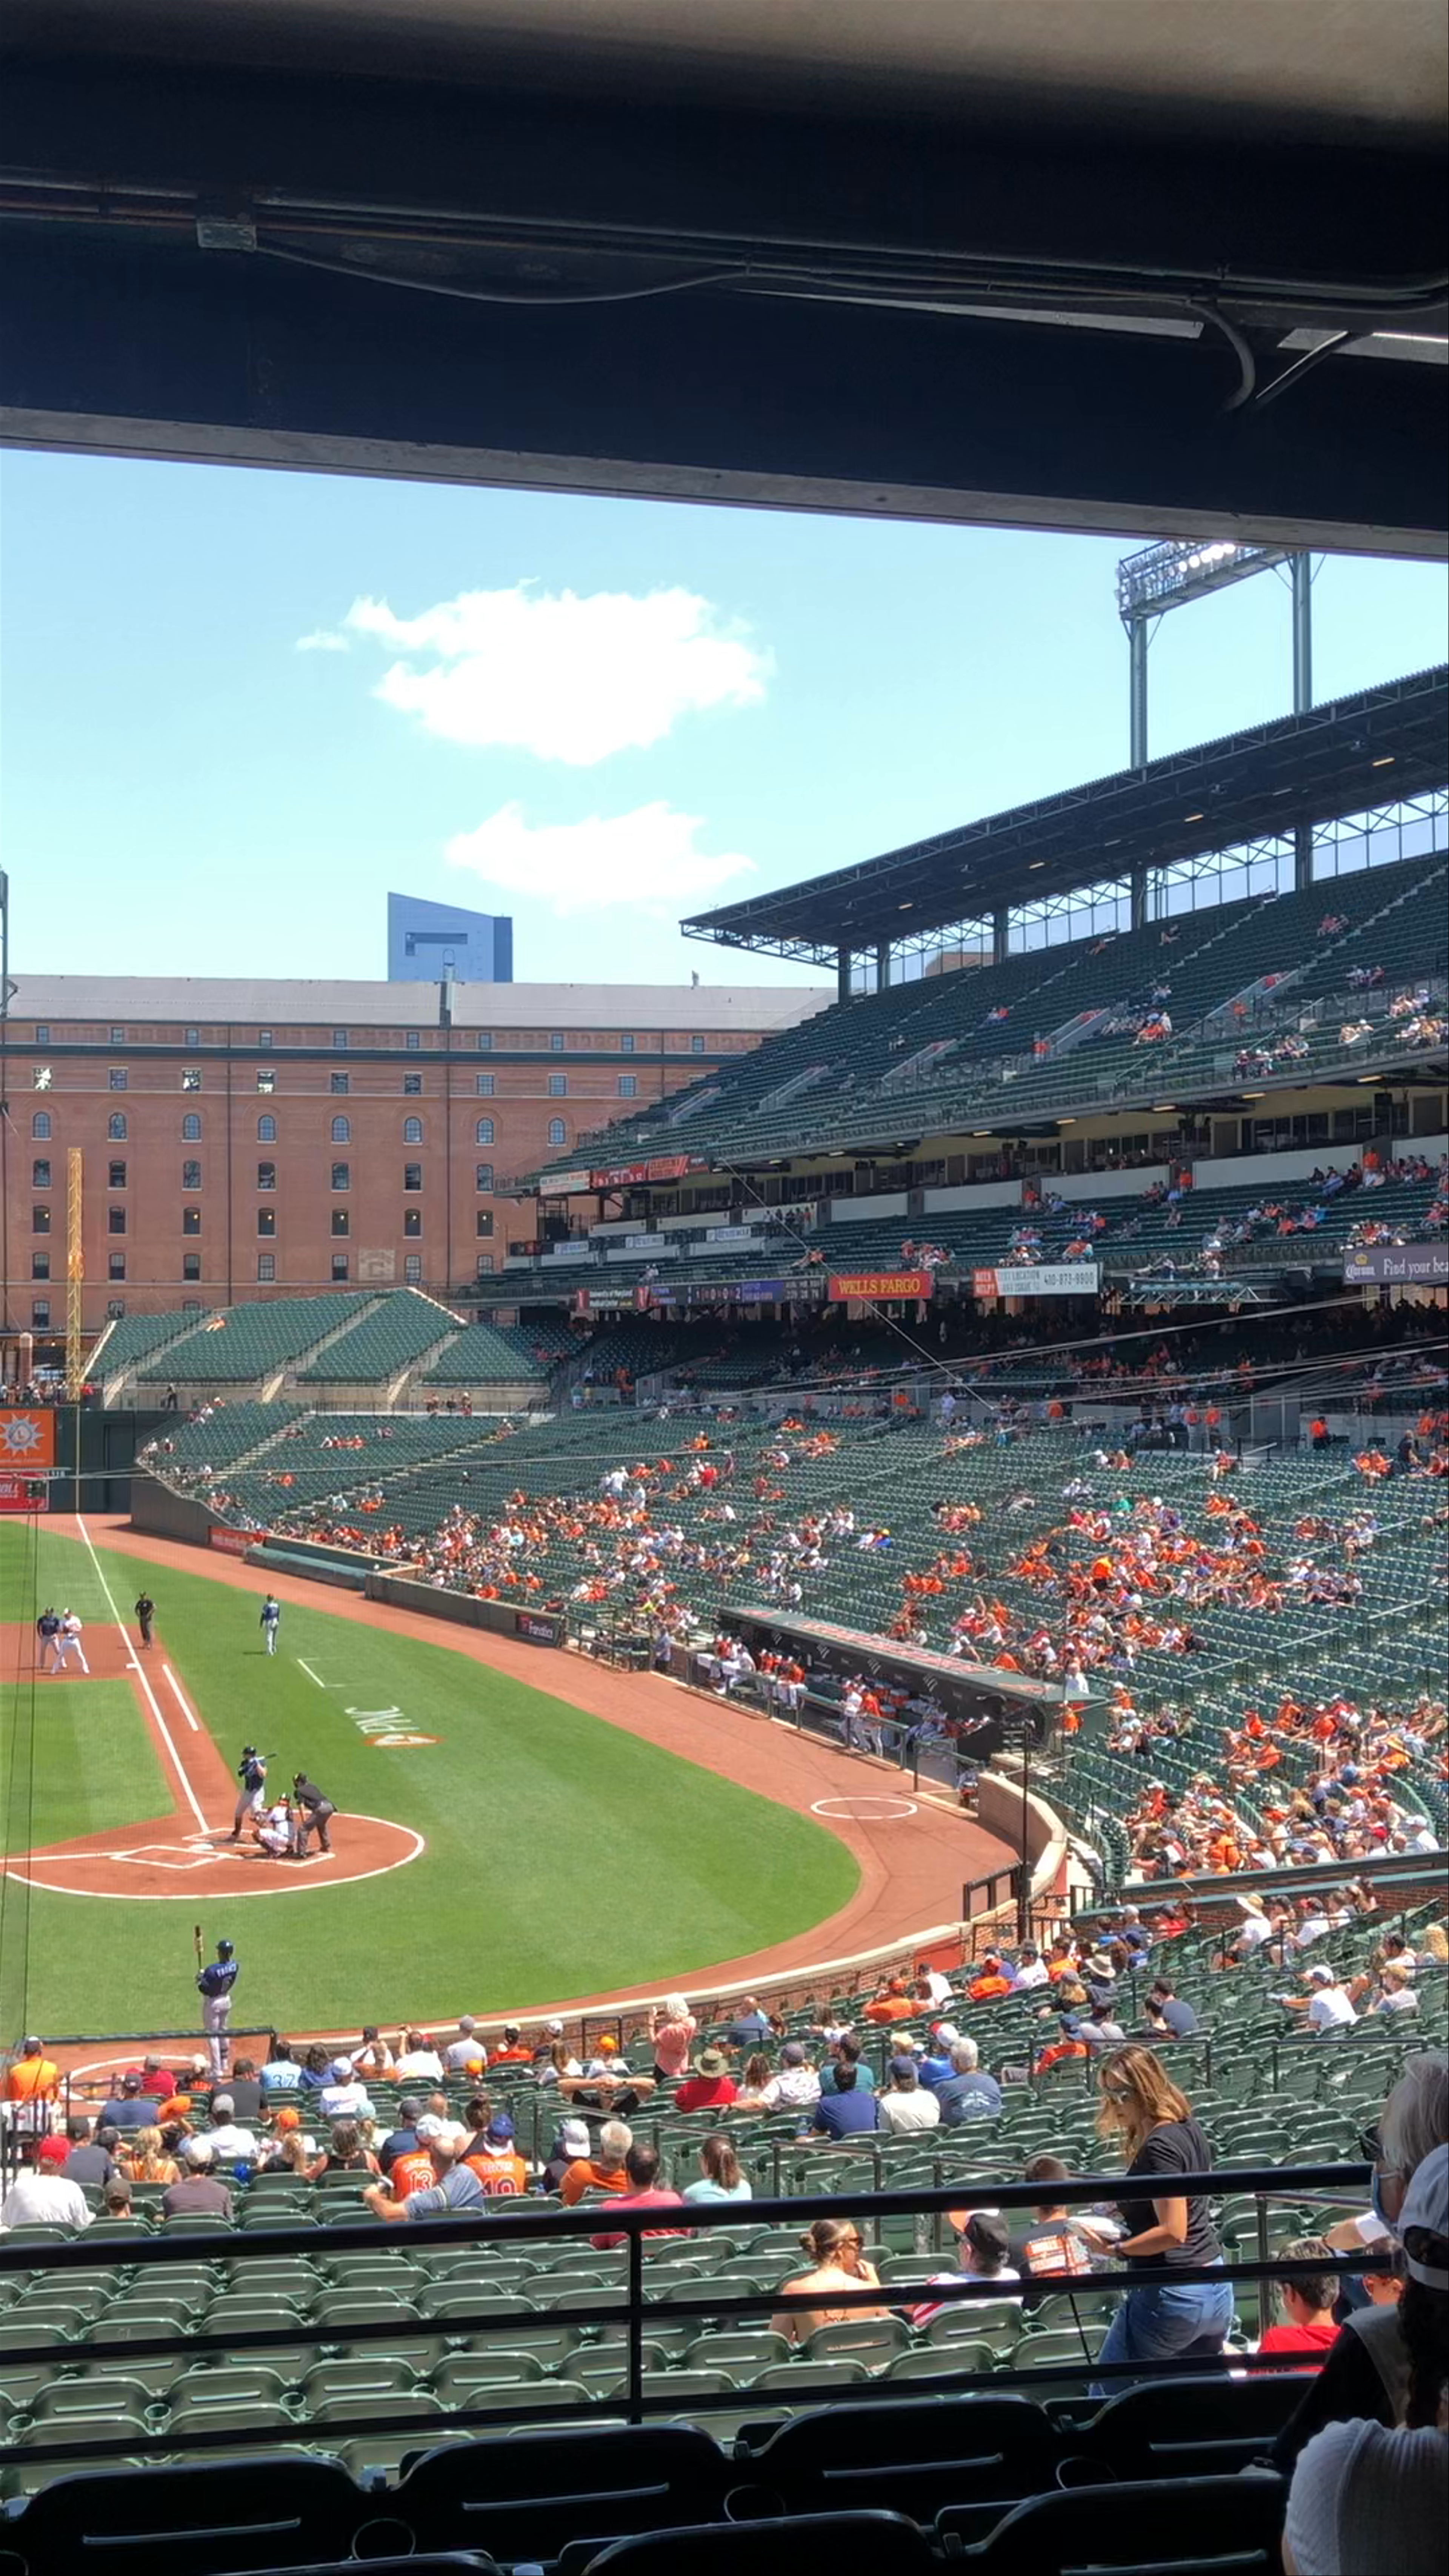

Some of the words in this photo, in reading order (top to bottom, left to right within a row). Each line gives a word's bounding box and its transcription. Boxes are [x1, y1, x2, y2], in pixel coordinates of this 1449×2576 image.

[1346, 1264, 1375, 1280] Corona
[1383, 1258, 1405, 1276] Find
[1408, 1263, 1431, 1280] your
[839, 1280, 878, 1295] WELLS
[880, 1278, 920, 1293] FARGO
